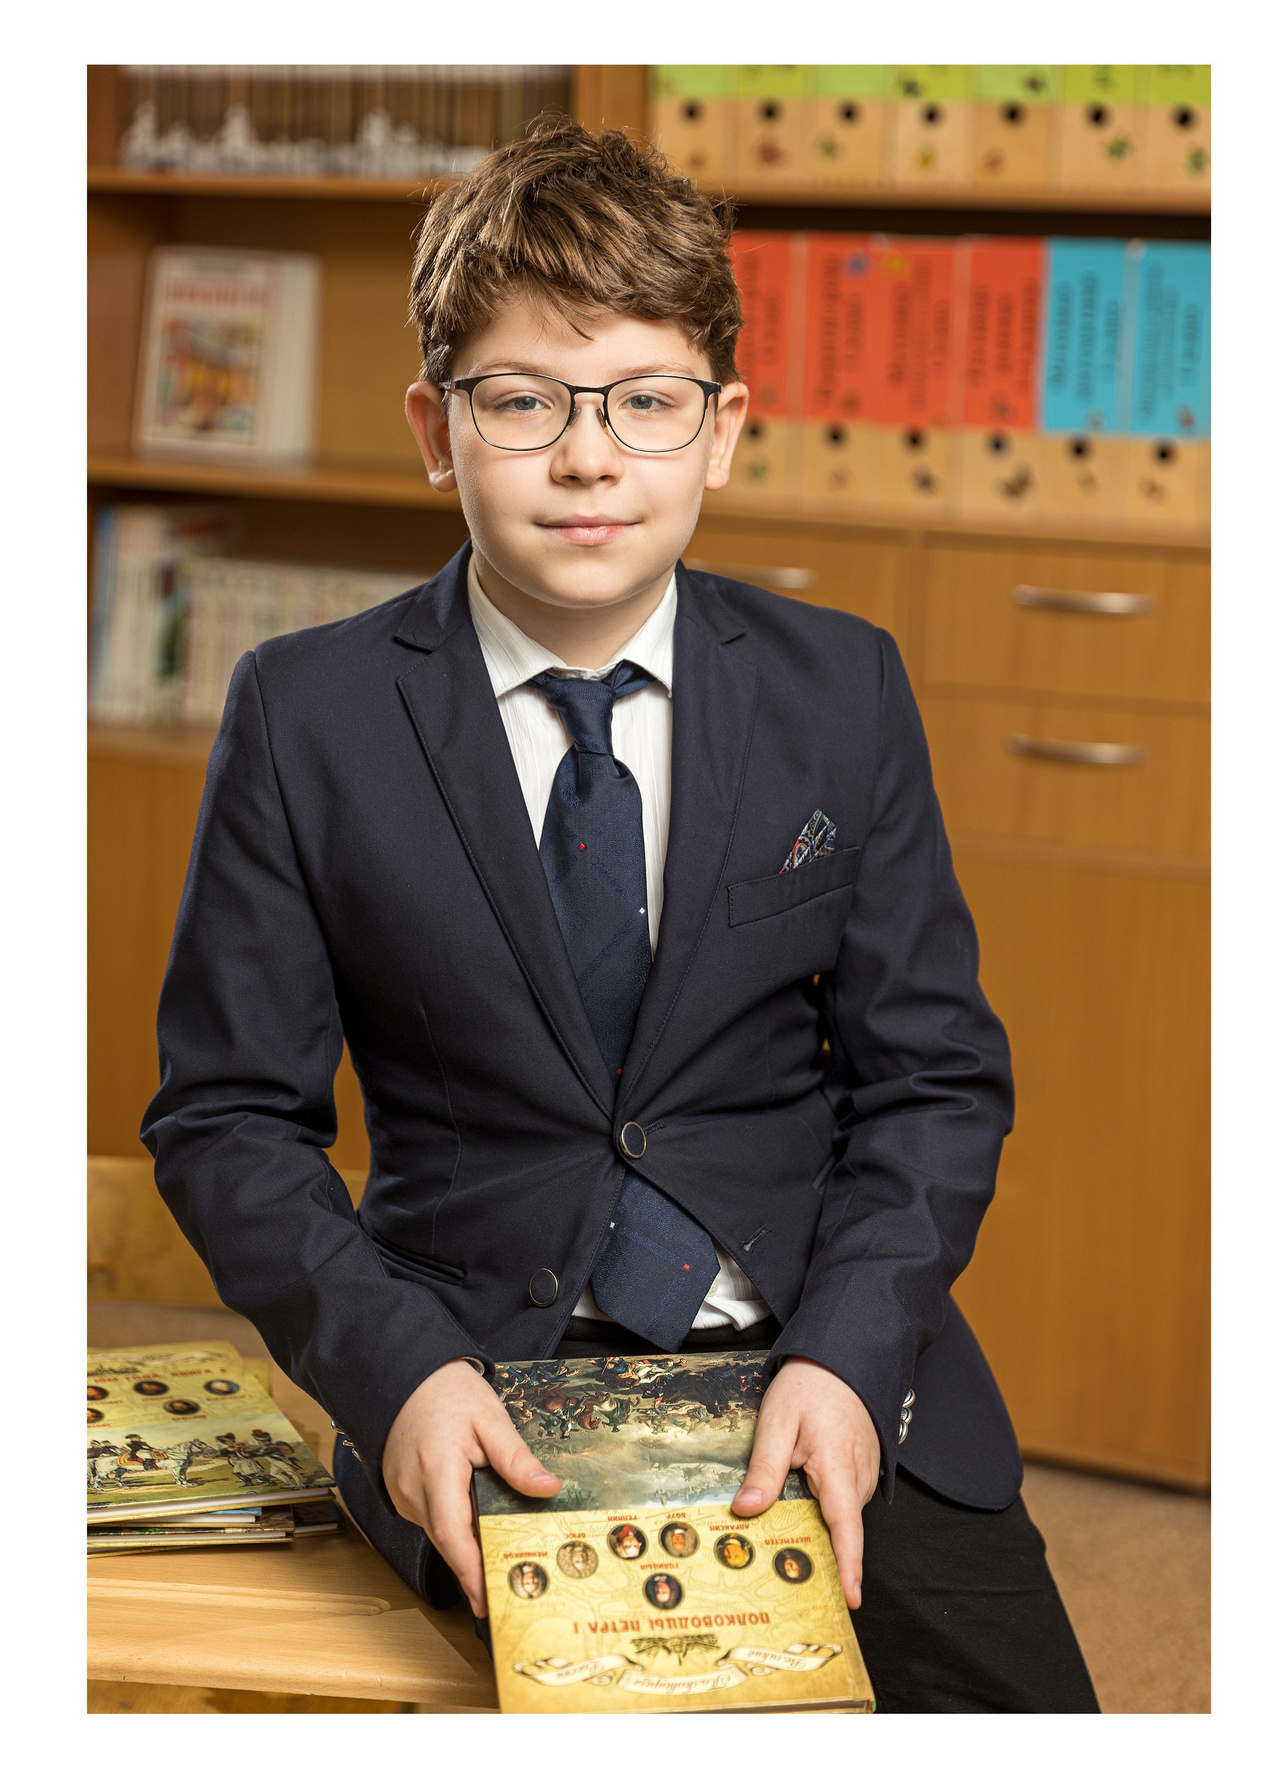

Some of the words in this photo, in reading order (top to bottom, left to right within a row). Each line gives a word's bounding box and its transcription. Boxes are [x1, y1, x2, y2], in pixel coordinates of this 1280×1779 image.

[709, 1523, 750, 1532] АПРАКСИН
[588, 1620, 641, 1633] ПЕТРА
[649, 1611, 771, 1633] ПОЛКОВОДЦЫ
